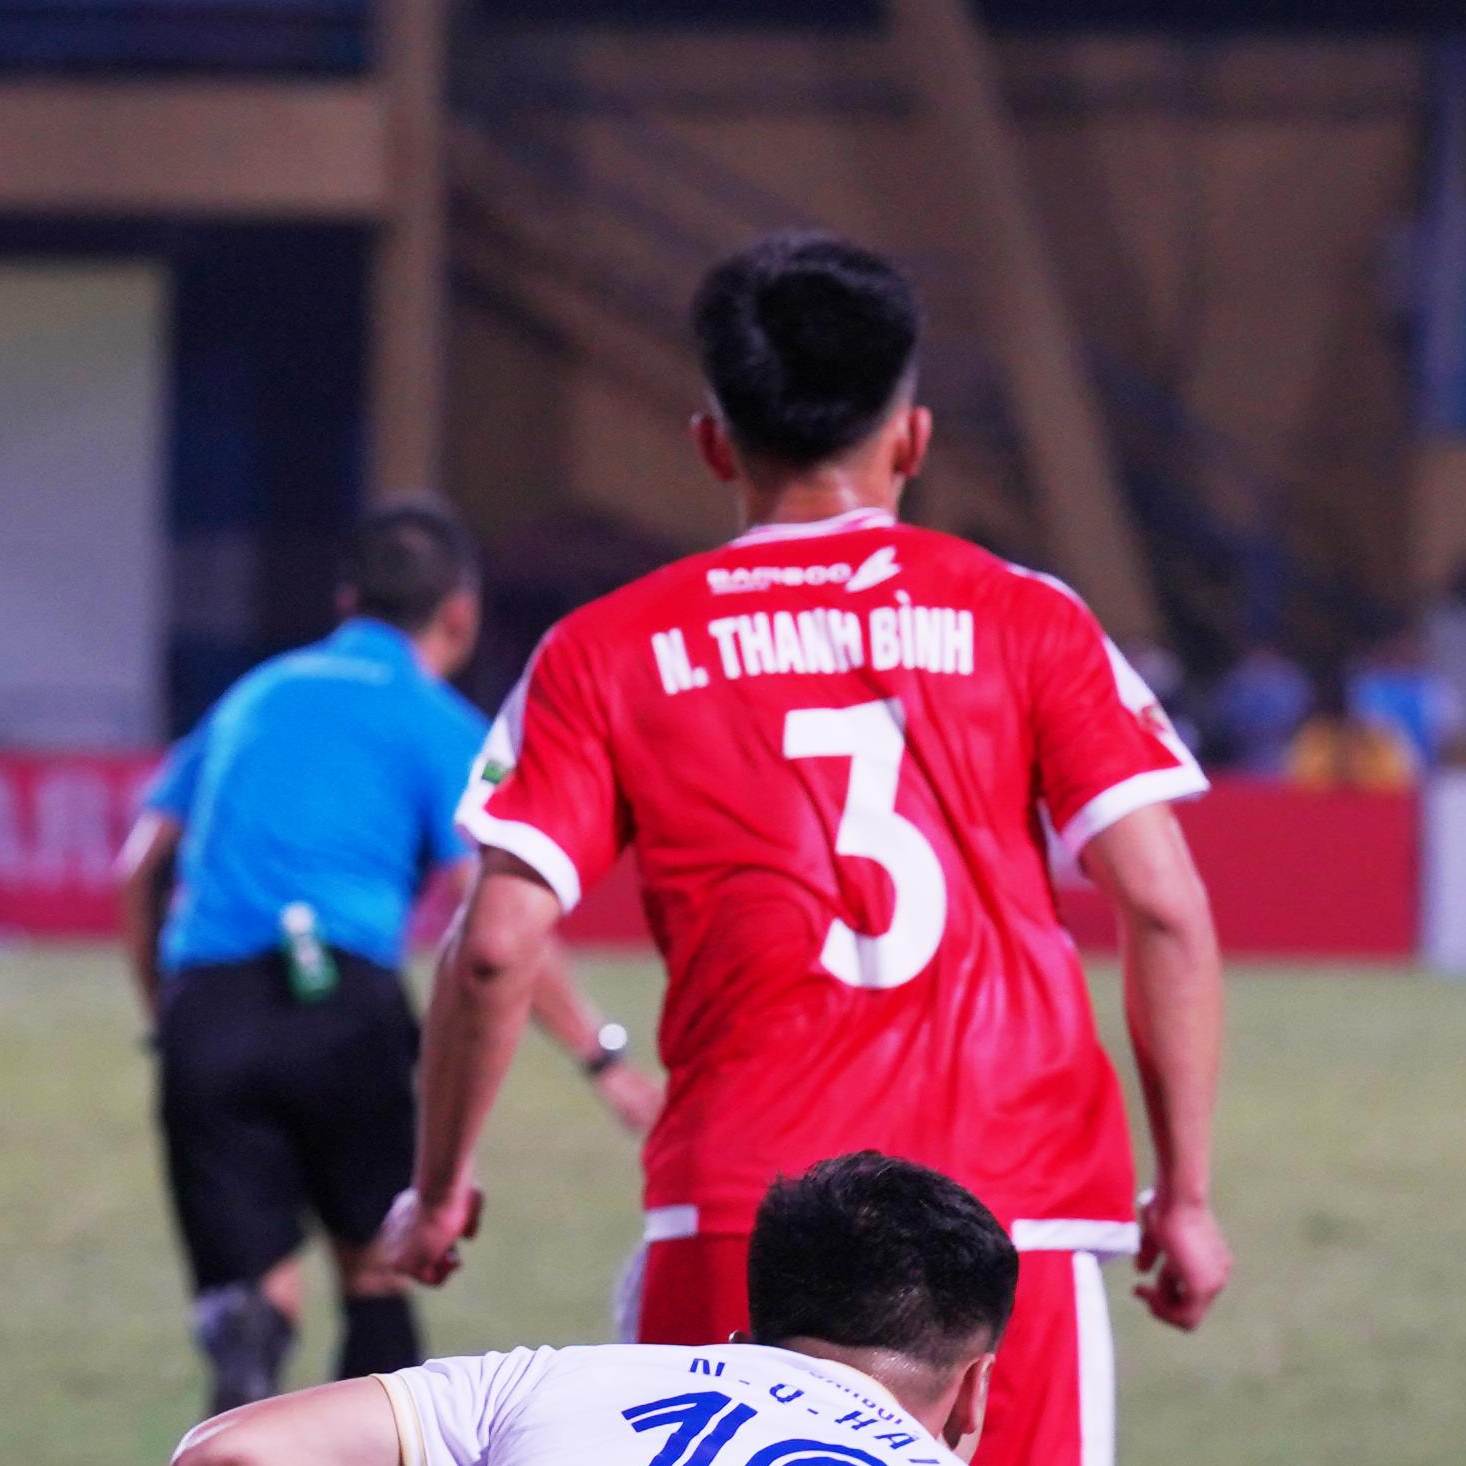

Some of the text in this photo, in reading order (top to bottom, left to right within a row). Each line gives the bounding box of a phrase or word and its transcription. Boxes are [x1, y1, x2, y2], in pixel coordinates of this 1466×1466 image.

[651, 589, 975, 696] N. THANH BÌNH
[783, 699, 947, 988] 3
